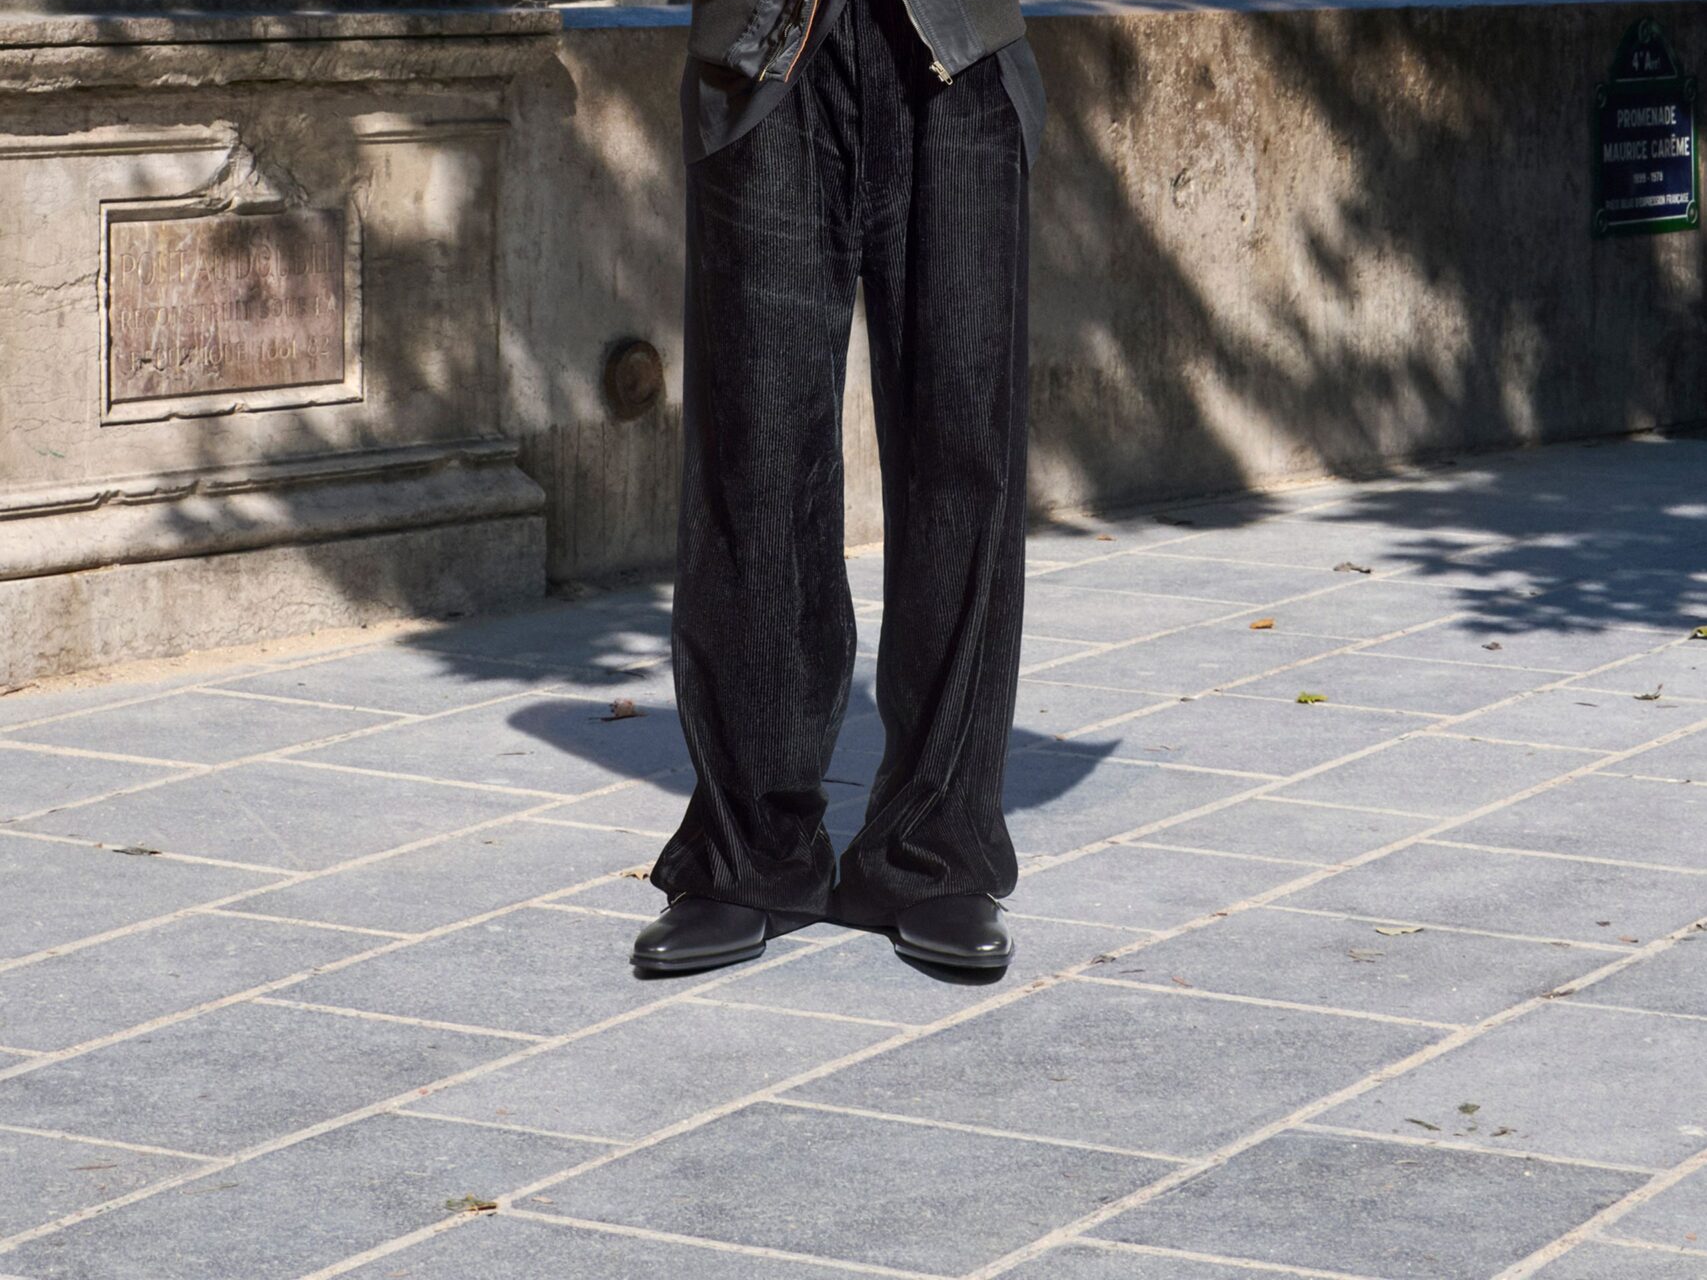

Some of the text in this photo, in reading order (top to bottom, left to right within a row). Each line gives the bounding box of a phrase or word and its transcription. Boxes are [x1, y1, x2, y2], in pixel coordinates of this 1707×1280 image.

[1616, 105, 1677, 129] PROMENADE
[1603, 133, 1690, 163] MAURICE CARÊME
[120, 249, 187, 287] PONT
